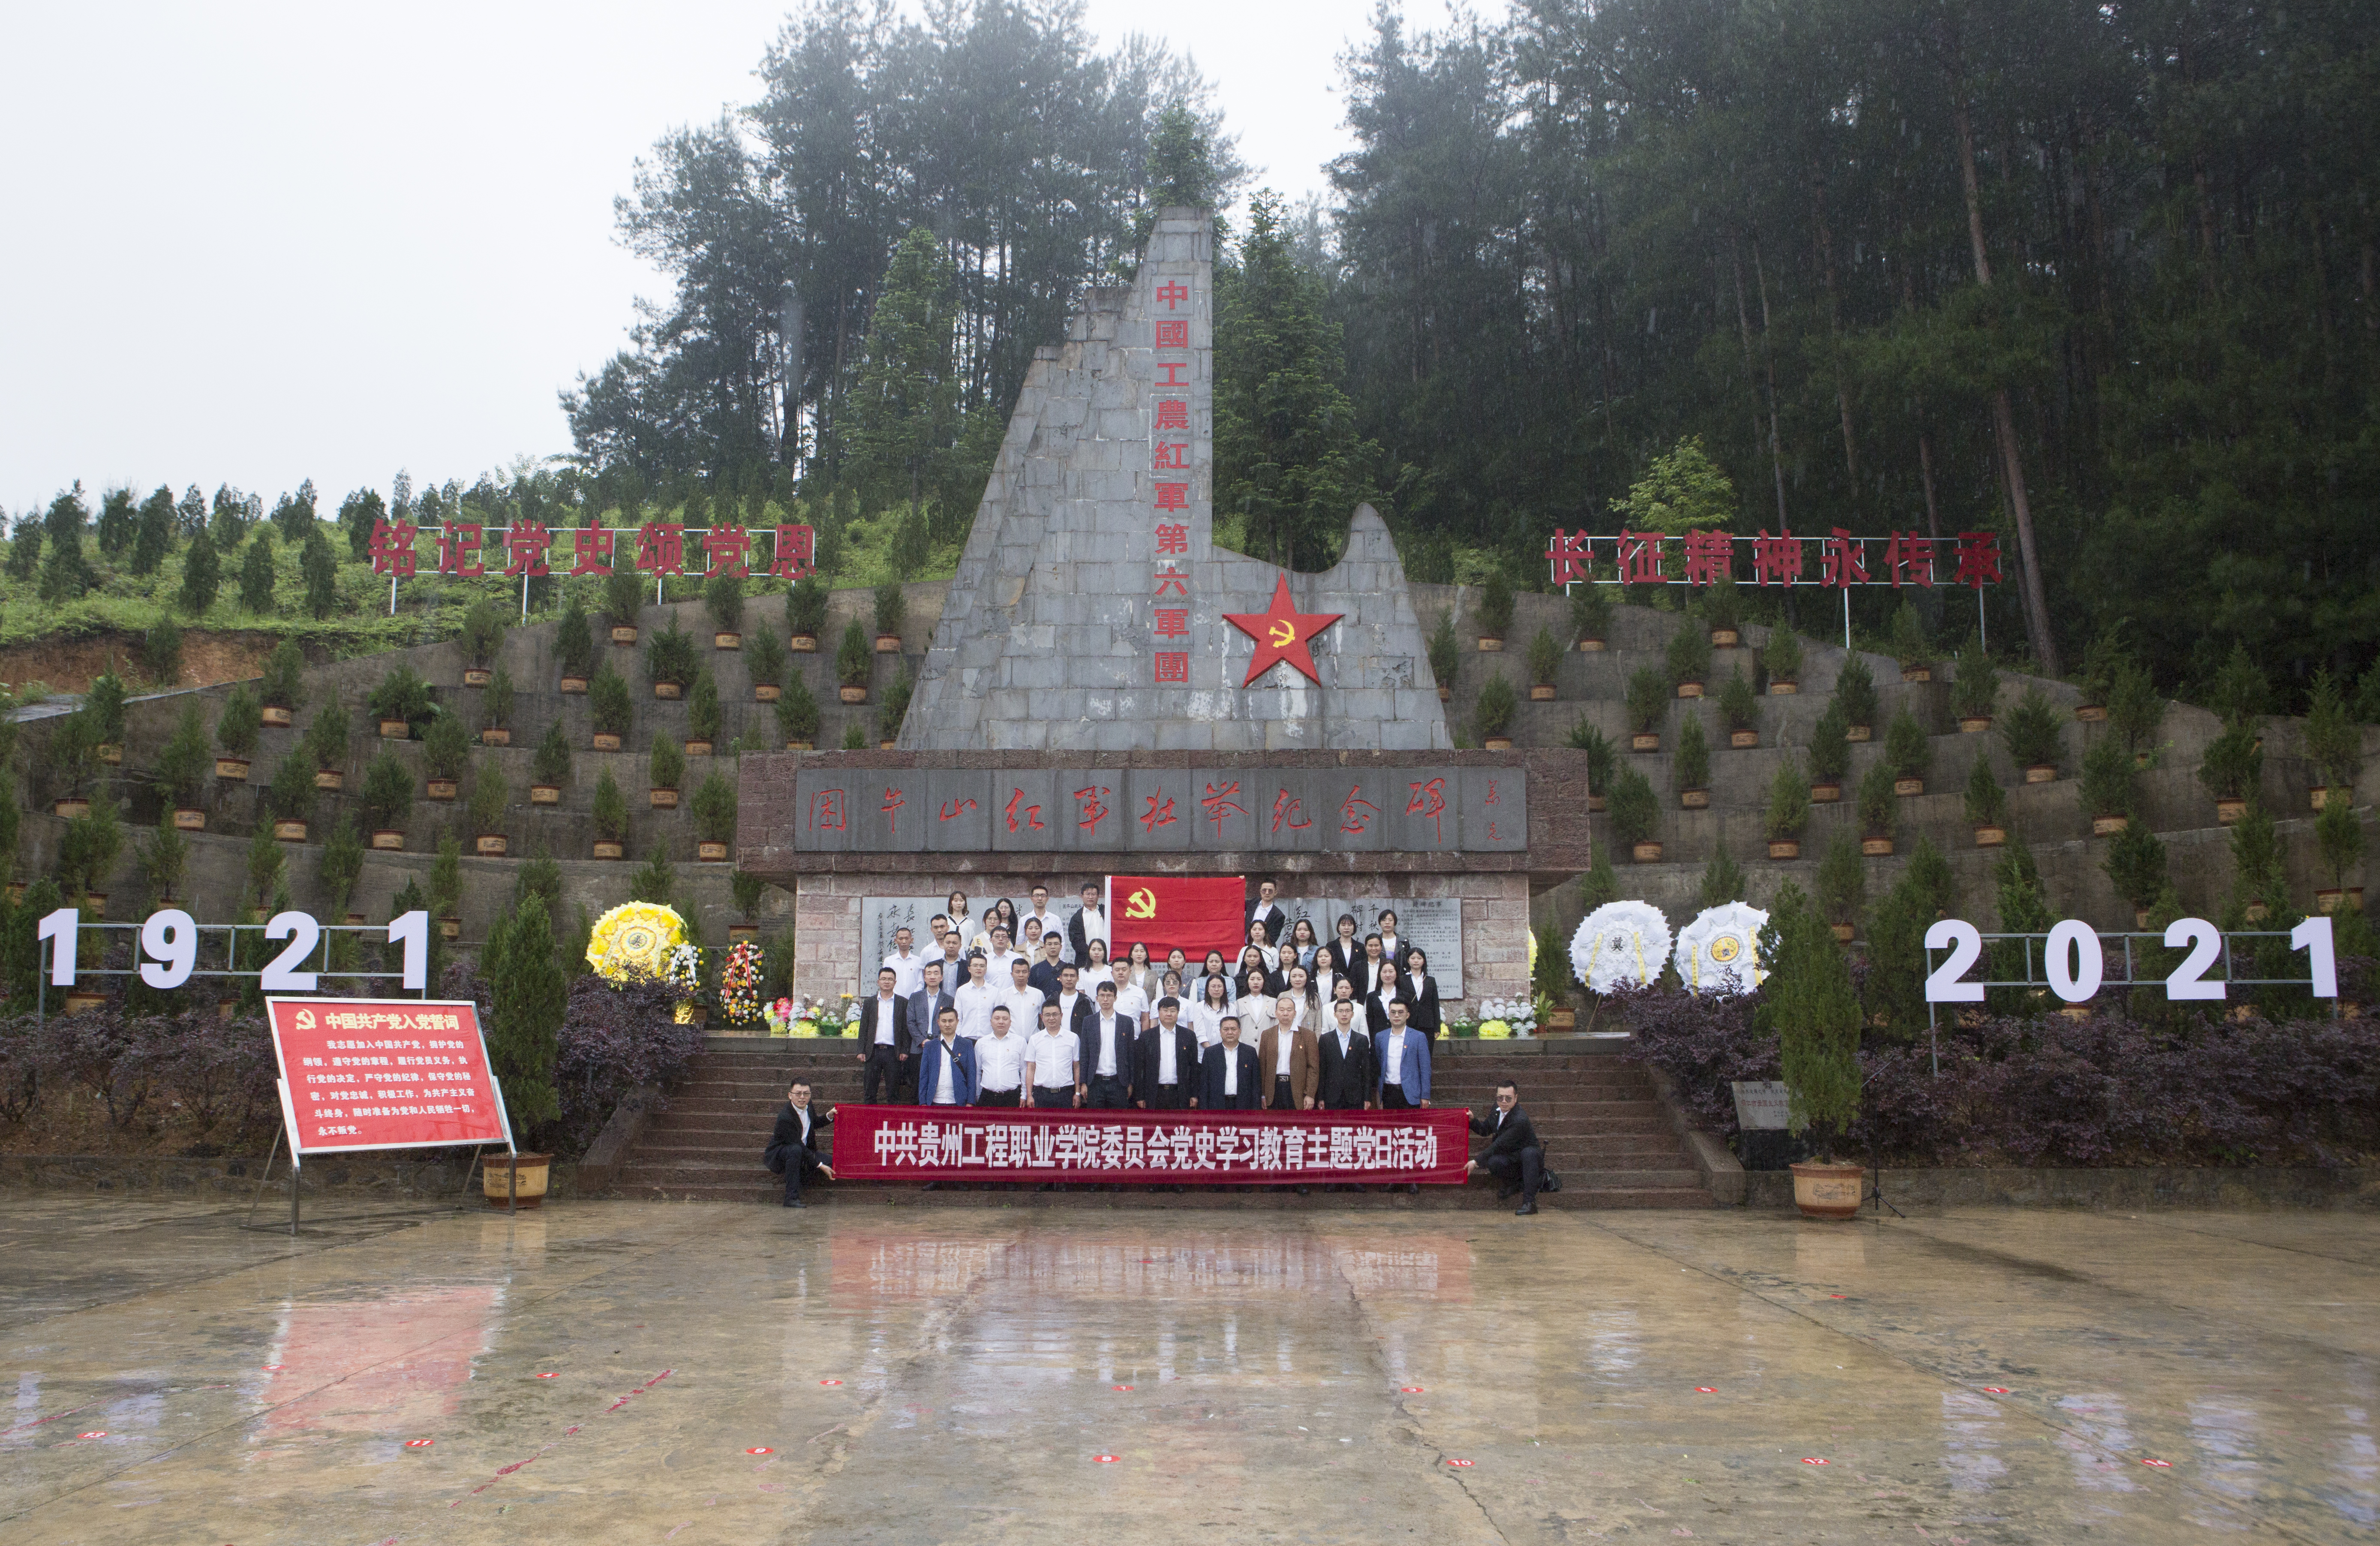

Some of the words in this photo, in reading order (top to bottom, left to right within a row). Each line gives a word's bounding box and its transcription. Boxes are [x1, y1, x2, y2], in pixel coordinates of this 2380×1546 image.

[1154, 280, 1190, 683] 中國工農紅軍第六軍團
[368, 518, 816, 579] 铭记党史颂党恩
[1545, 527, 2004, 589] 长征精神永传承
[38, 908, 428, 990] 1921
[1611, 937, 1623, 952] 奠
[1924, 917, 2338, 1002] 2021
[325, 1013, 460, 1030] 中国共产党入党誓词
[327, 1040, 464, 1050] 我志愿加入中国共产党，拥护党的
[318, 1125, 362, 1136] 永不叛党。
[874, 1121, 1437, 1171] 中共贵州工程职业学院委员会党史学习教育主题党日活动
